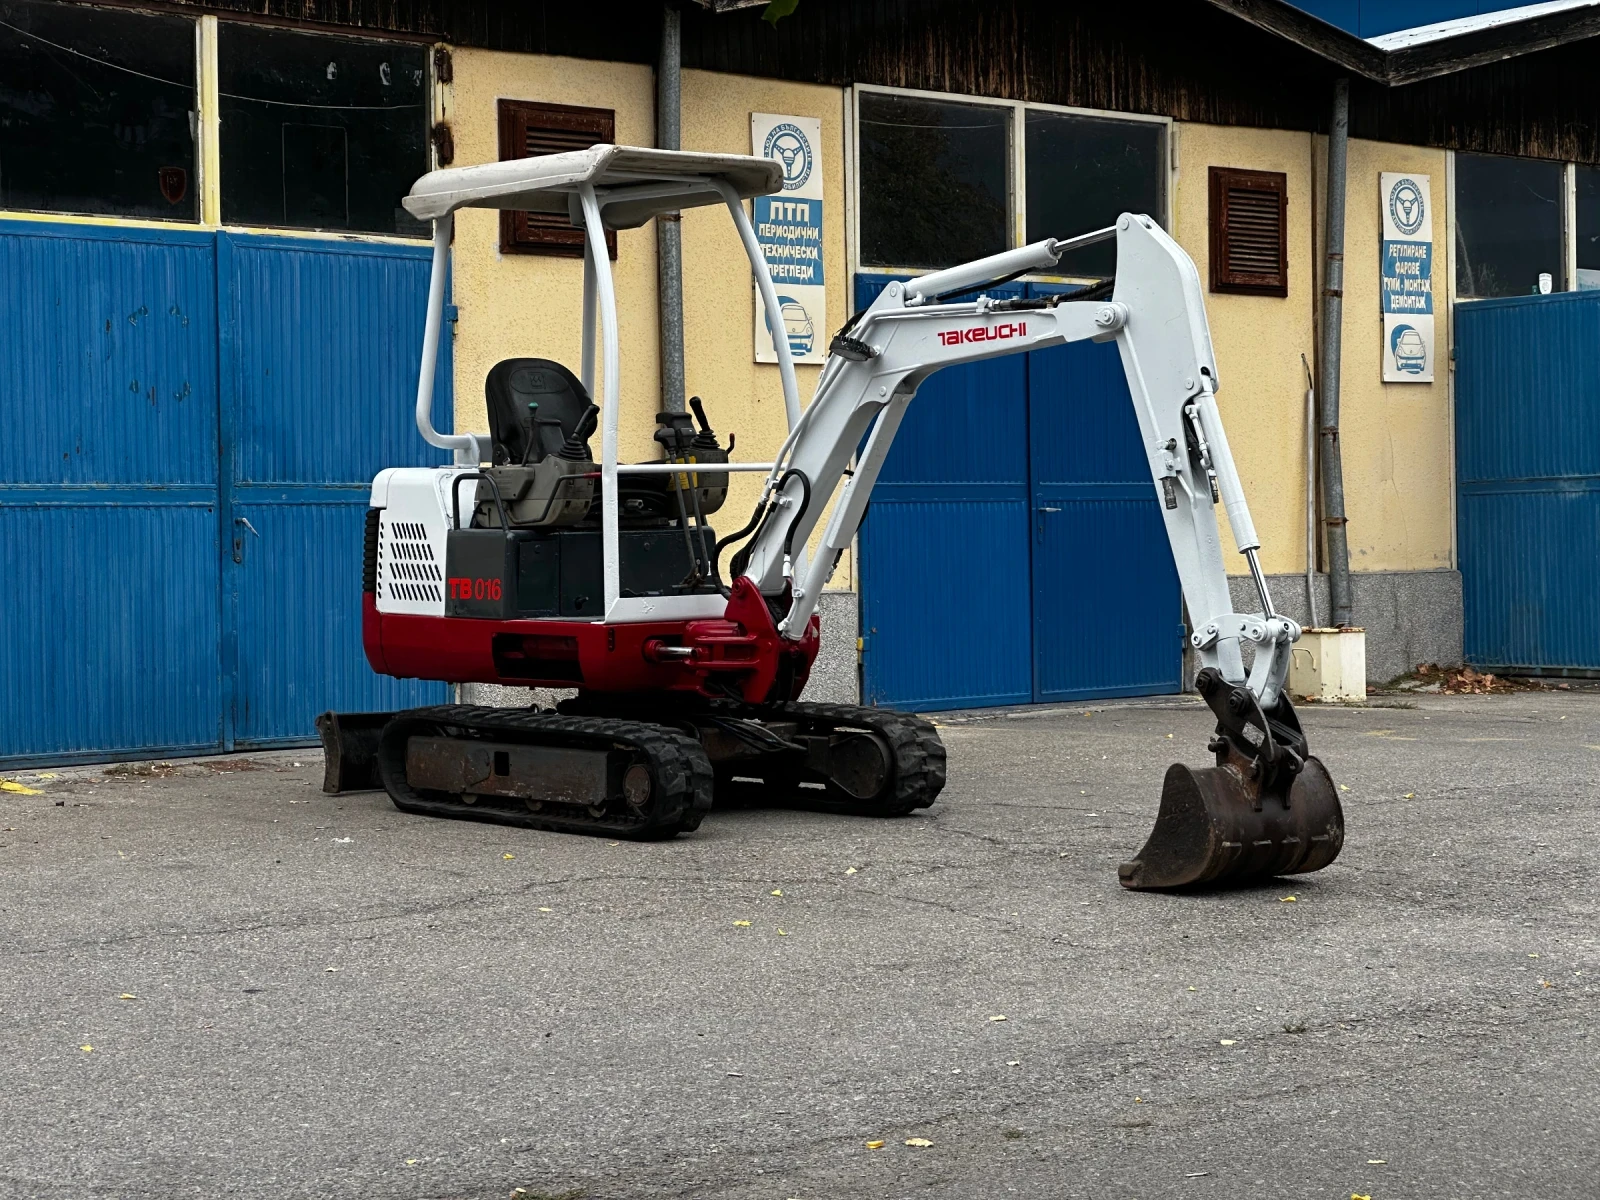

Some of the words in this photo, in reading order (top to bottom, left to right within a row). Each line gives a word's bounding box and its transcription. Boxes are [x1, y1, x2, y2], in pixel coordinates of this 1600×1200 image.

[770, 201, 809, 222] ПТП
[758, 223, 819, 239] ПЕРИОДИЧНИ
[760, 243, 818, 259] ТЕХНИЧЕСКИ
[1389, 244, 1427, 258] РЕГУЛИРАНЕ
[1395, 261, 1420, 274] ФАРОВЕ
[1404, 278, 1431, 292] МОНТАЖ
[1391, 295, 1426, 309] ДЕМОНТАЖ
